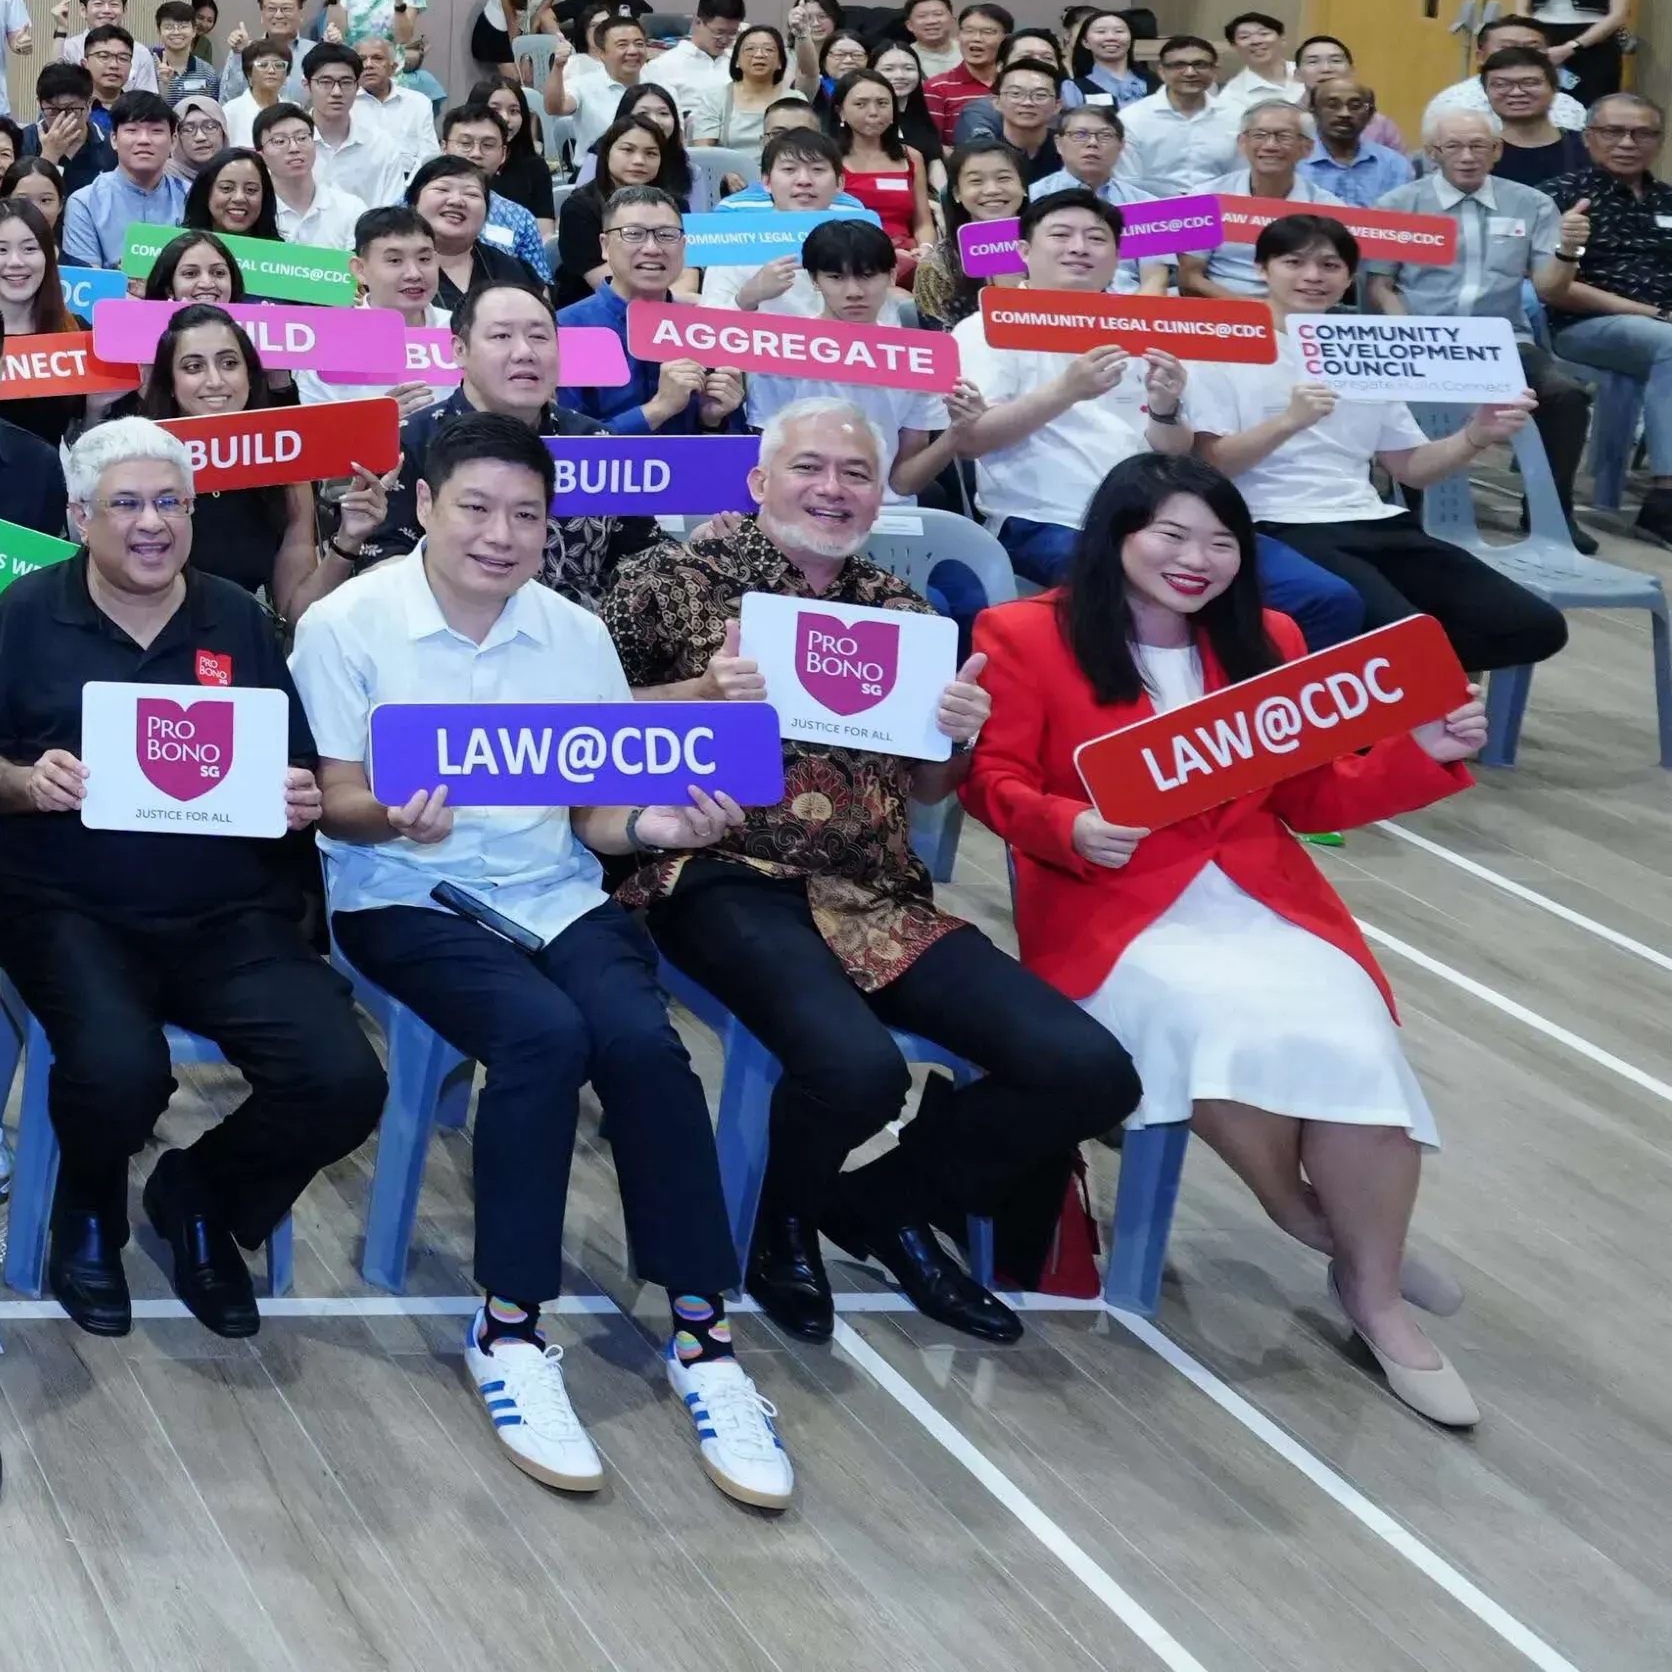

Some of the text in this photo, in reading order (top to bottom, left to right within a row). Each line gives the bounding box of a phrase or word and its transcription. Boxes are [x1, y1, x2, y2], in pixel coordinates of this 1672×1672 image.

[685, 232, 756, 245] OMMUNITY
[759, 231, 797, 243] LEGAL
[261, 262, 351, 284] CLINICS@CDC
[991, 310, 1268, 340] COMMUNITY LEGAL CLINICS@CDC
[1299, 324, 1461, 342] COMMUNITY
[652, 320, 935, 375] AGGREGATE
[1303, 342, 1503, 362] DEVELOPMENT
[1306, 360, 1426, 378] COUNCIL
[186, 430, 302, 471] BUILD
[554, 459, 670, 494] BUILD
[808, 630, 857, 656] PRO
[199, 656, 218, 669] PRO
[199, 666, 227, 679] BONO
[807, 652, 883, 682] BONO
[861, 683, 882, 696] SG
[147, 716, 195, 740] PRO
[791, 718, 893, 742] JUSTICE FOR ALL
[1140, 657, 1404, 792] LAW@CDC
[147, 739, 220, 763] BONO
[437, 726, 716, 783] LAW@CDC
[200, 766, 220, 778] SG
[135, 809, 232, 823] JUSTICE FOR ALL
